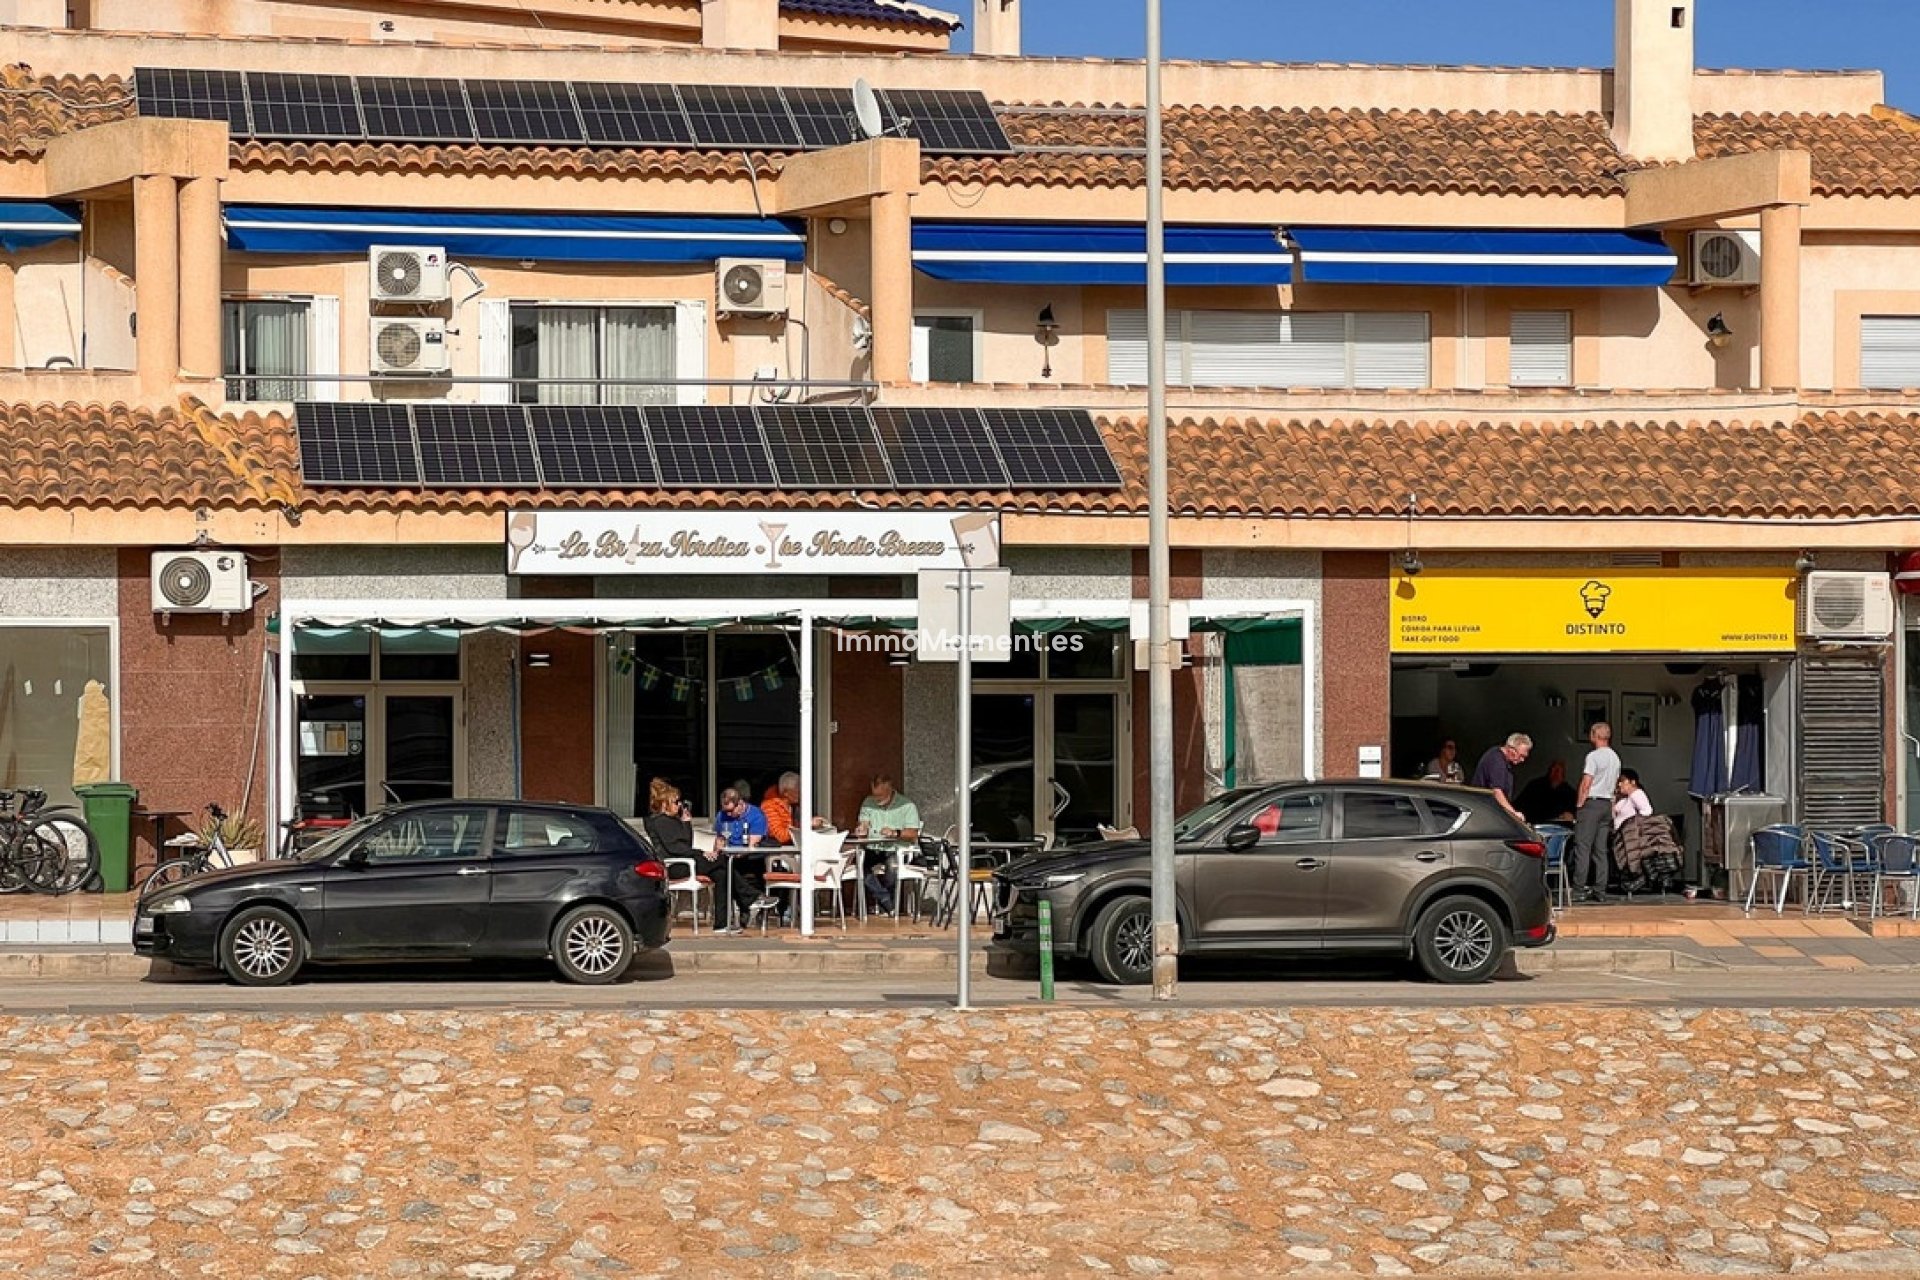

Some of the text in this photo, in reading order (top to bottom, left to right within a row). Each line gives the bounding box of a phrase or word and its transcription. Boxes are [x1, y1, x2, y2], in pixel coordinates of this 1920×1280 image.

[558, 530, 590, 559] La
[664, 530, 750, 559] Nordica
[806, 530, 876, 558] Nordic
[876, 529, 946, 557] Breeze
[1565, 623, 1626, 635] DISTINTO
[1439, 635, 1460, 643] FOOD
